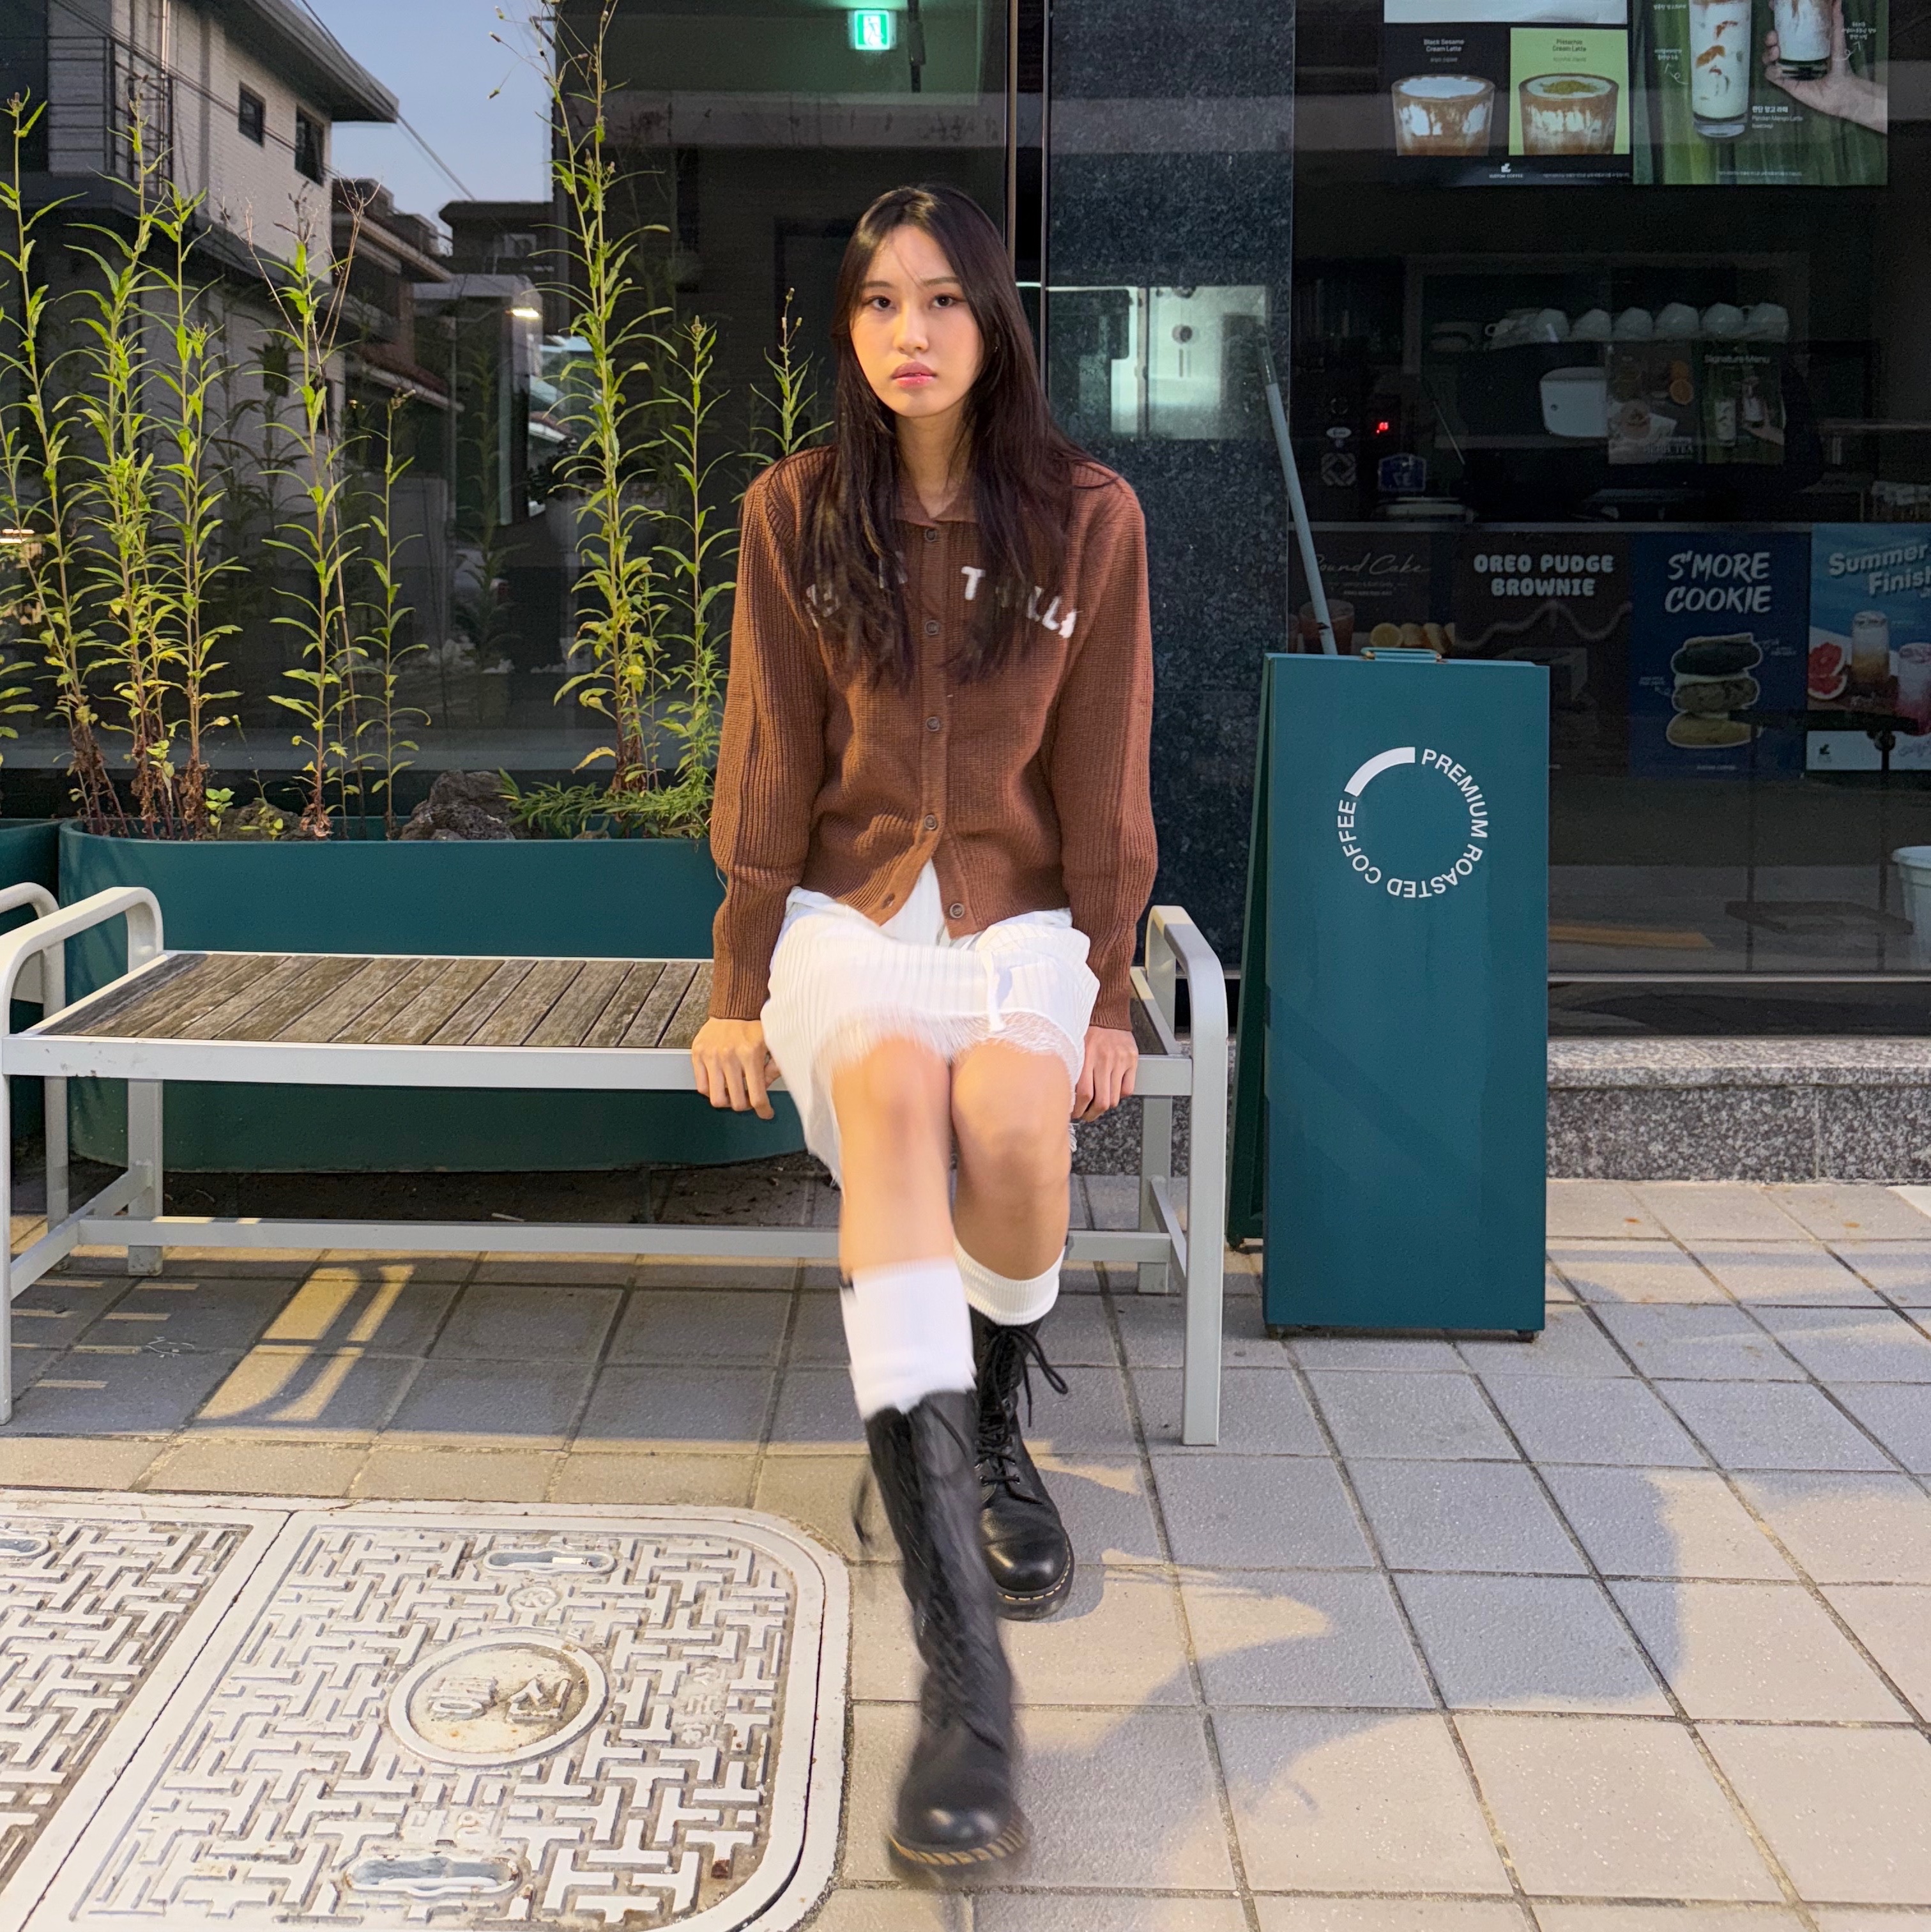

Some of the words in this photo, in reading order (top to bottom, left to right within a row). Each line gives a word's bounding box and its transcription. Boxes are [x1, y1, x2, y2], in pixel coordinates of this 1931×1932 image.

[1369, 553, 1431, 574] Cake
[1473, 554, 1532, 573] OREO
[1540, 554, 1614, 573] PUDGE
[1667, 550, 1771, 582] S'MORE
[1828, 543, 1929, 576] Summer
[1491, 578, 1596, 597] BROWNIE
[1665, 584, 1773, 613] COOKIE
[1421, 747, 1488, 839] PREMIUM
[1338, 799, 1382, 885] COFFEE
[1386, 843, 1484, 899] ROASTED
